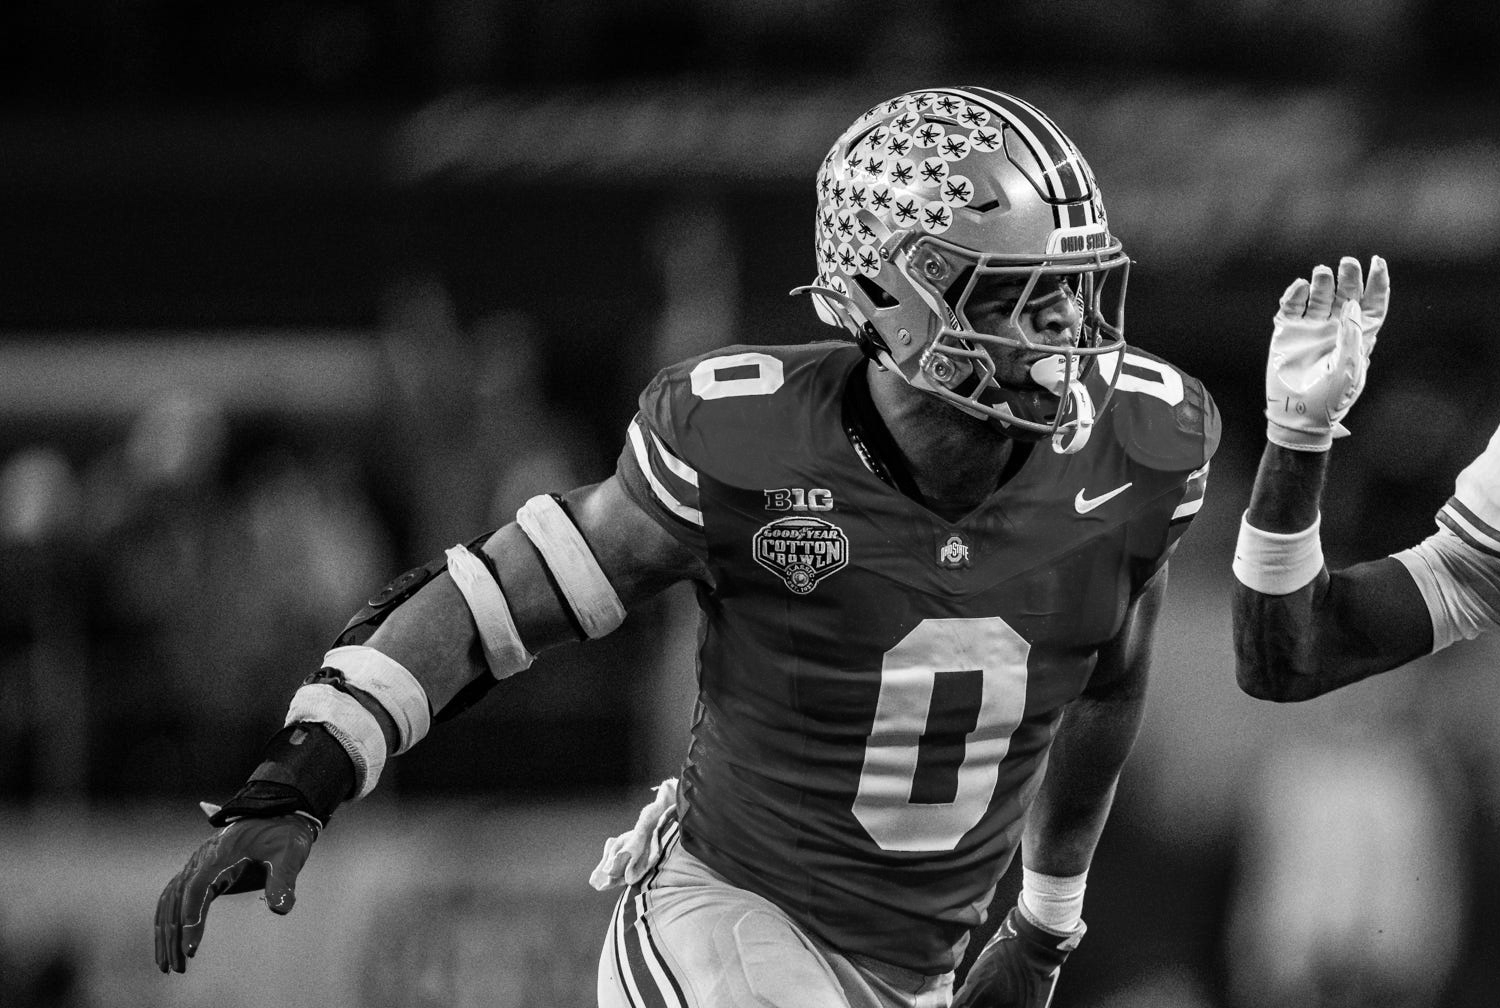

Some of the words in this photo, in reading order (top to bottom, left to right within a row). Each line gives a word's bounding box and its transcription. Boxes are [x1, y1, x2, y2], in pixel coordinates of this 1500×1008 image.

[1061, 235, 1085, 254] OHIO
[690, 352, 785, 401] 0
[763, 529, 839, 540] GOODYEAR
[762, 539, 840, 565] COTTON
[776, 553, 826, 569] BOWL
[851, 616, 1032, 852] 0
